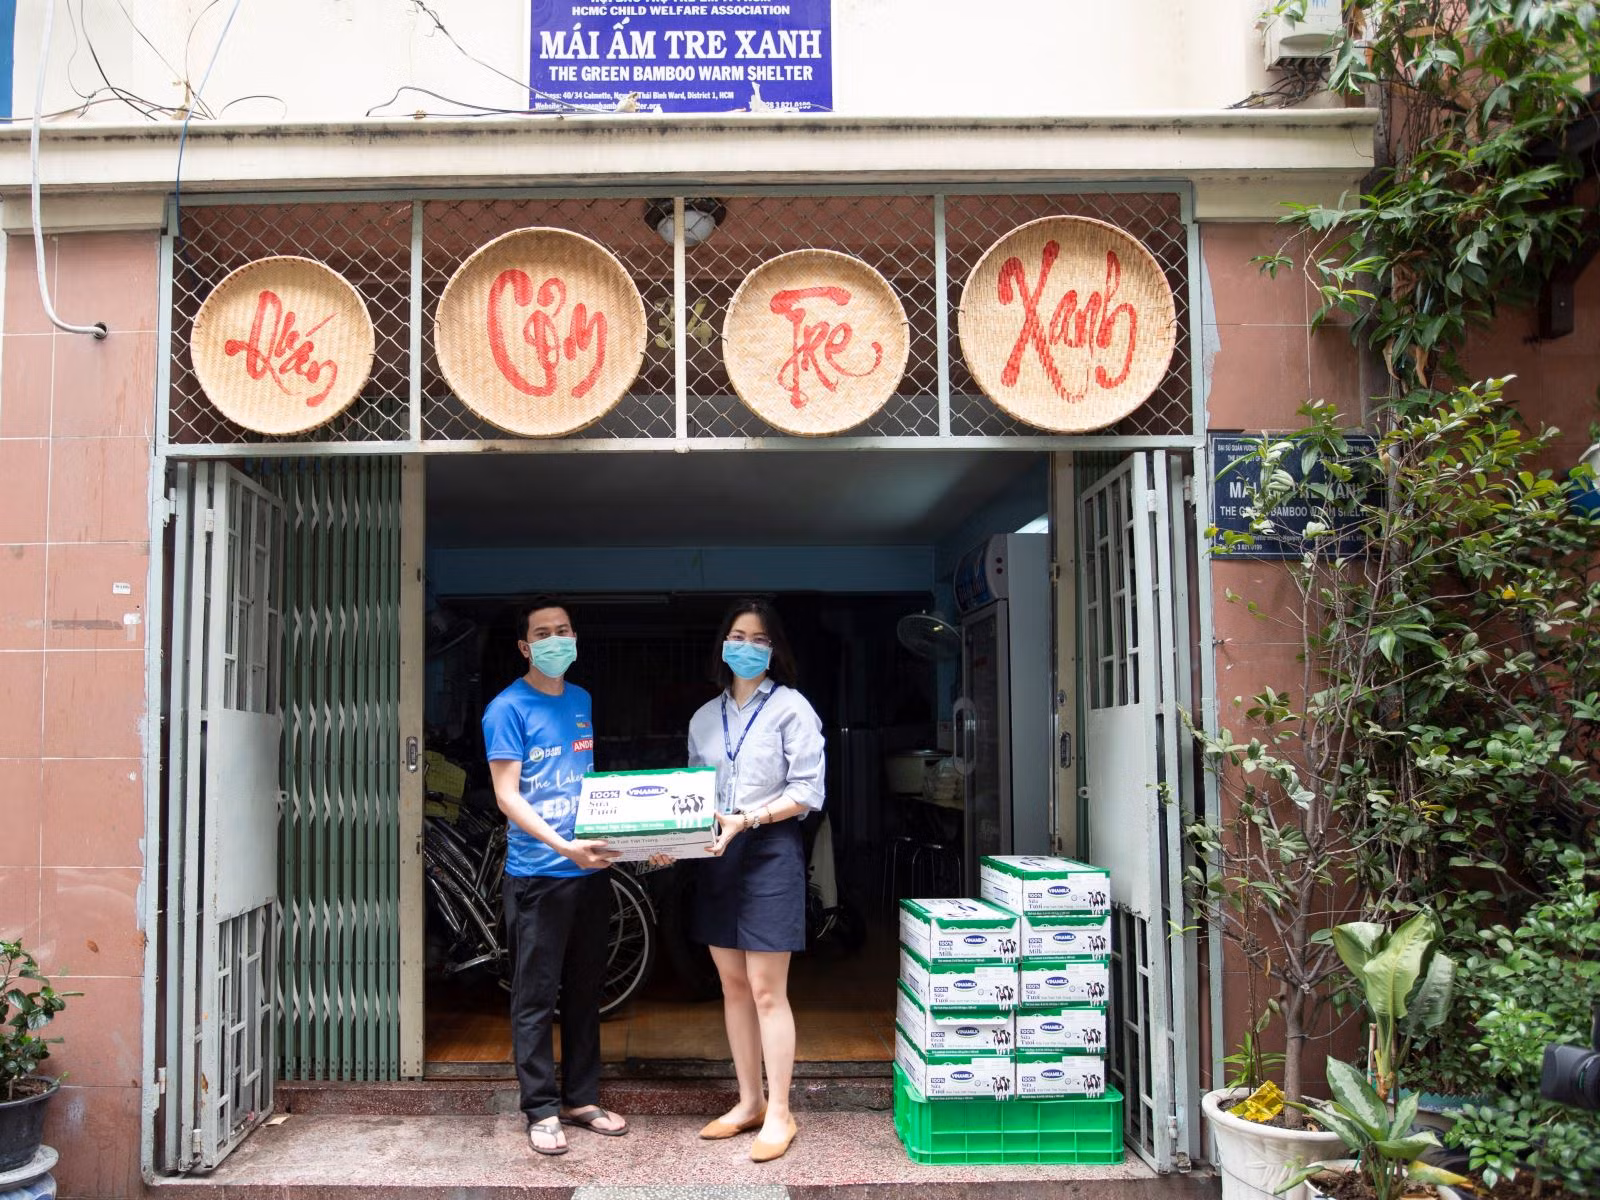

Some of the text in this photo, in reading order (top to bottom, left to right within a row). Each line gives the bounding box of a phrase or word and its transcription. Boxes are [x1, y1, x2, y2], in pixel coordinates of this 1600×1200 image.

[571, 5, 790, 16] HCMC CHILD WELFARE ASSOCIATION
[539, 17, 822, 60] MÁI ẤM TRE XANH
[549, 65, 813, 81] THE GREEN BAMBOO WARM SHELTER
[687, 91, 711, 100] District
[1220, 505, 1237, 517] THE
[1270, 506, 1308, 517] BAMBOO
[591, 786, 667, 799] 100% VINAMILK
